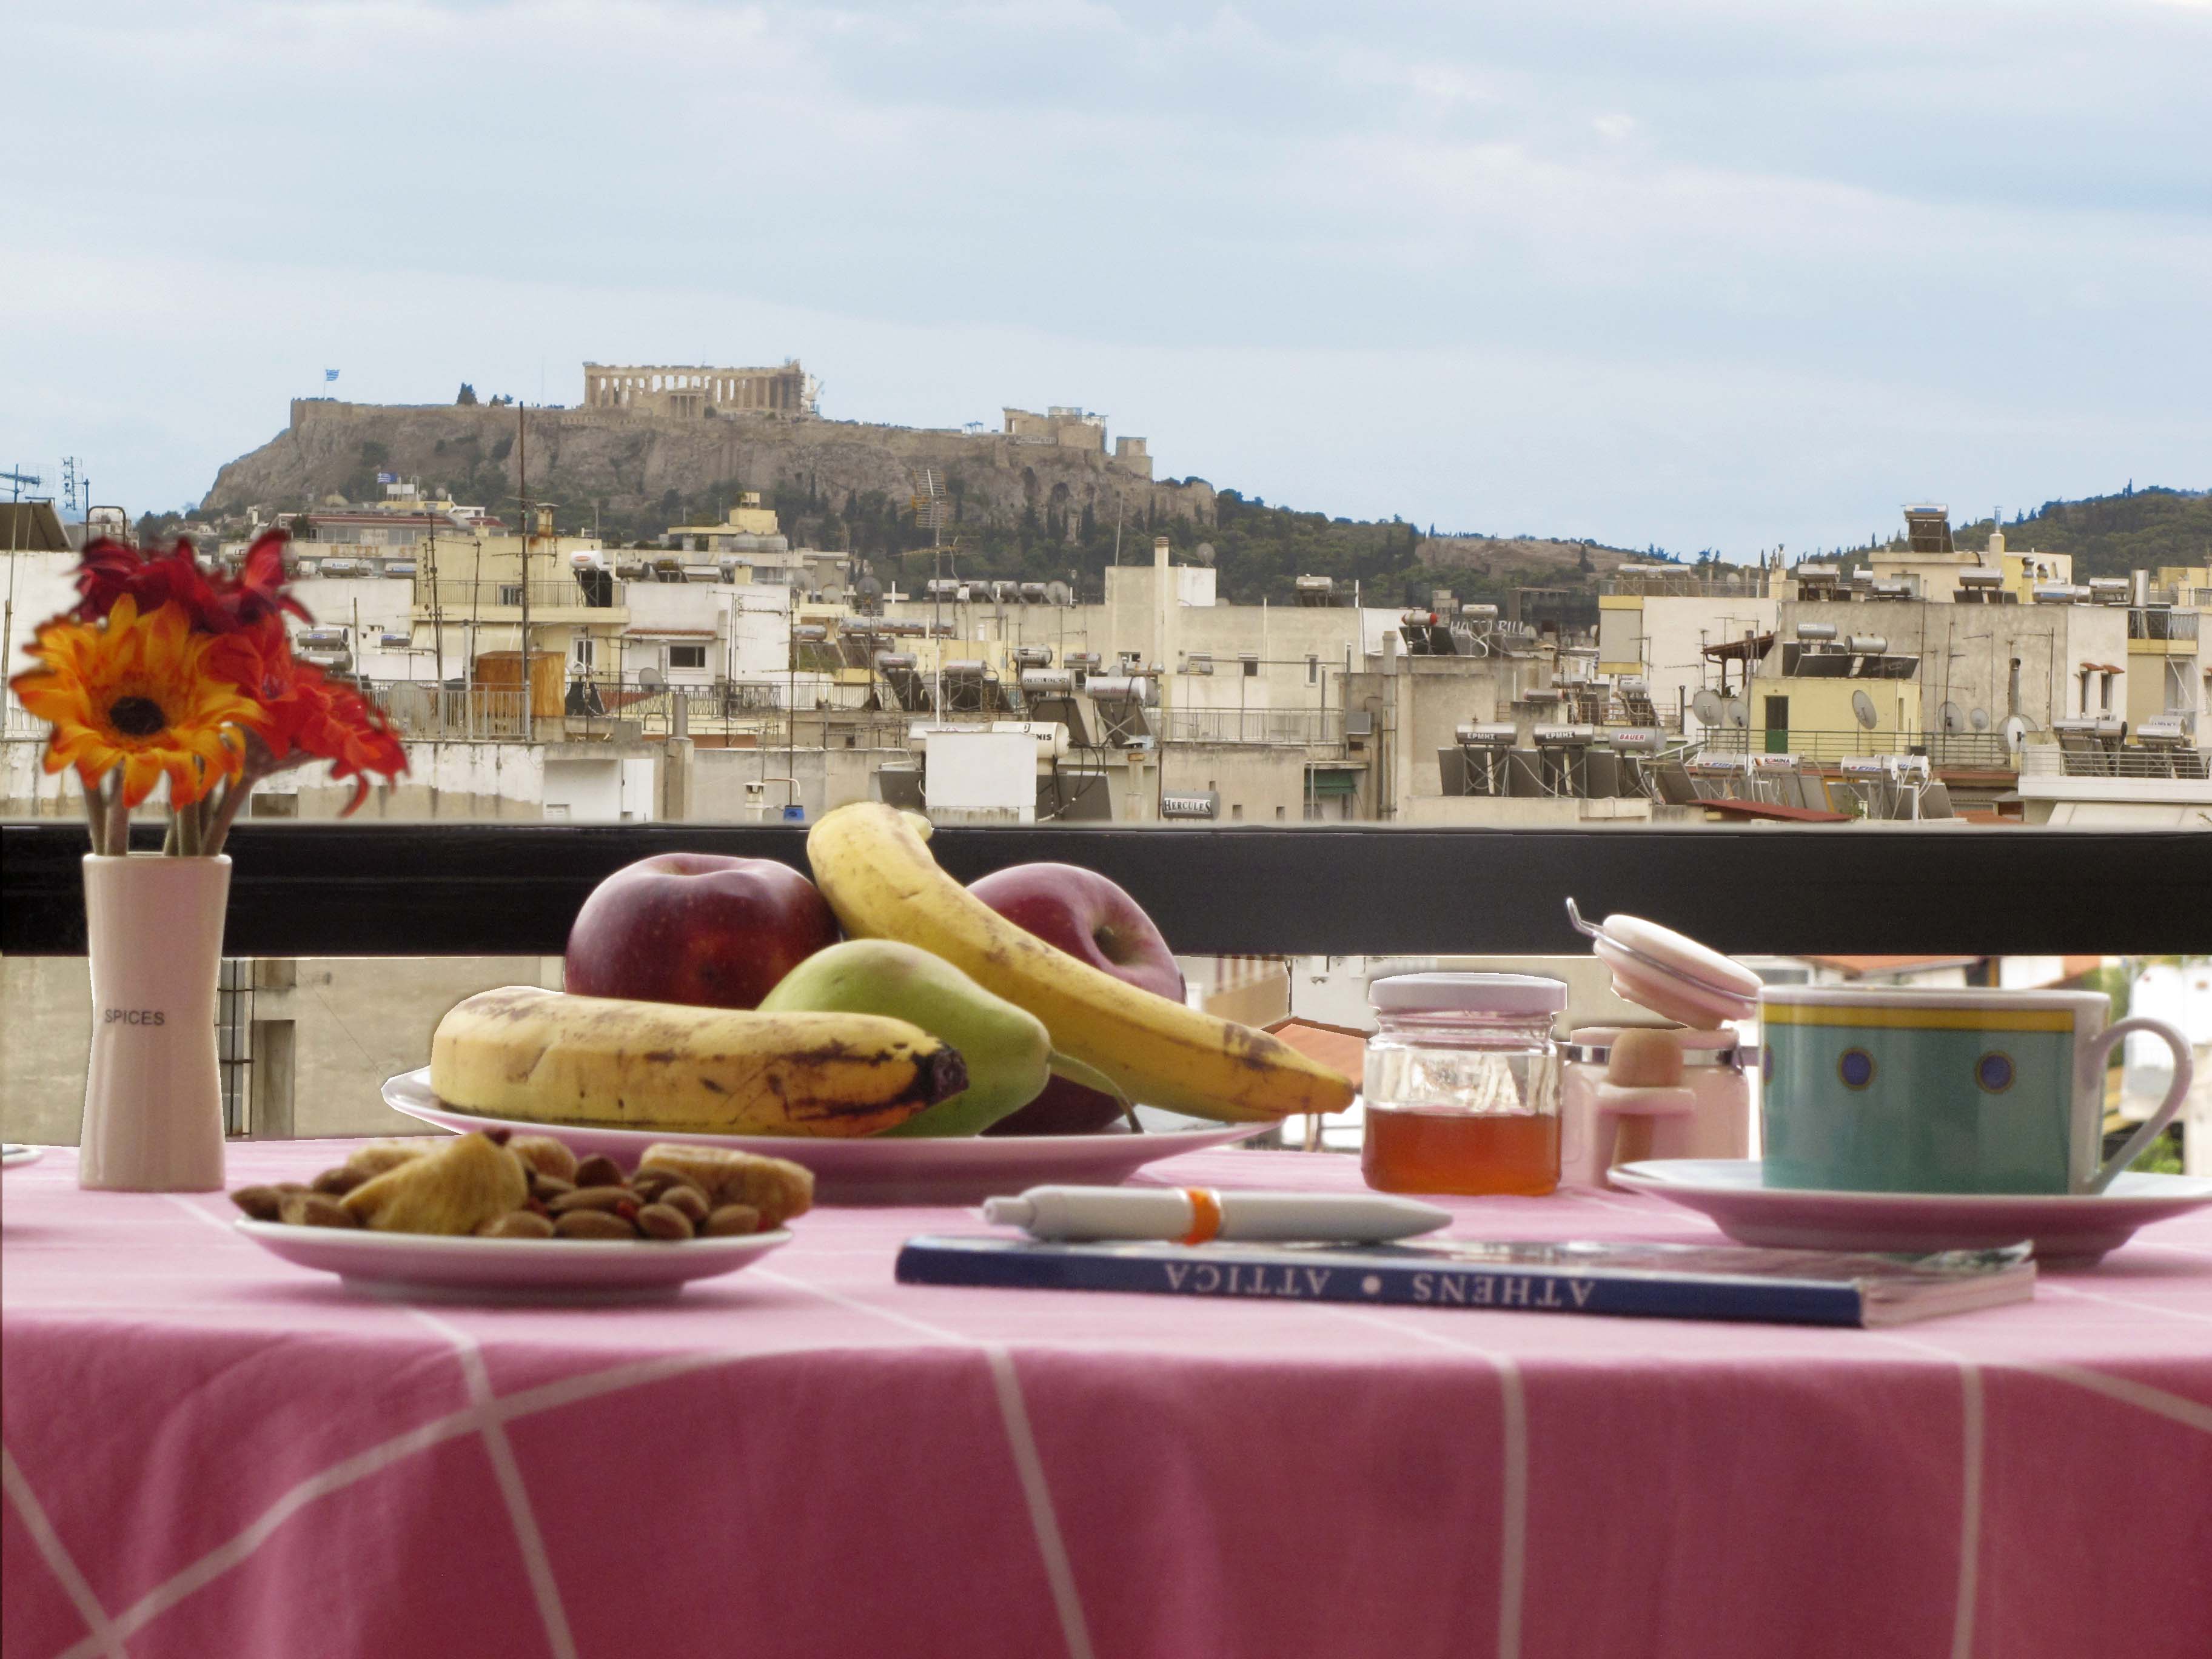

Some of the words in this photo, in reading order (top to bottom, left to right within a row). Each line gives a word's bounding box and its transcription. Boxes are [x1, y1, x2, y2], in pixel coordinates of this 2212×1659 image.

[1164, 800, 1212, 813] HERCULES
[104, 1008, 166, 1025] SPICES
[1165, 1263, 1332, 1296] ATTICA
[1412, 1272, 1595, 1307] ATHENS
